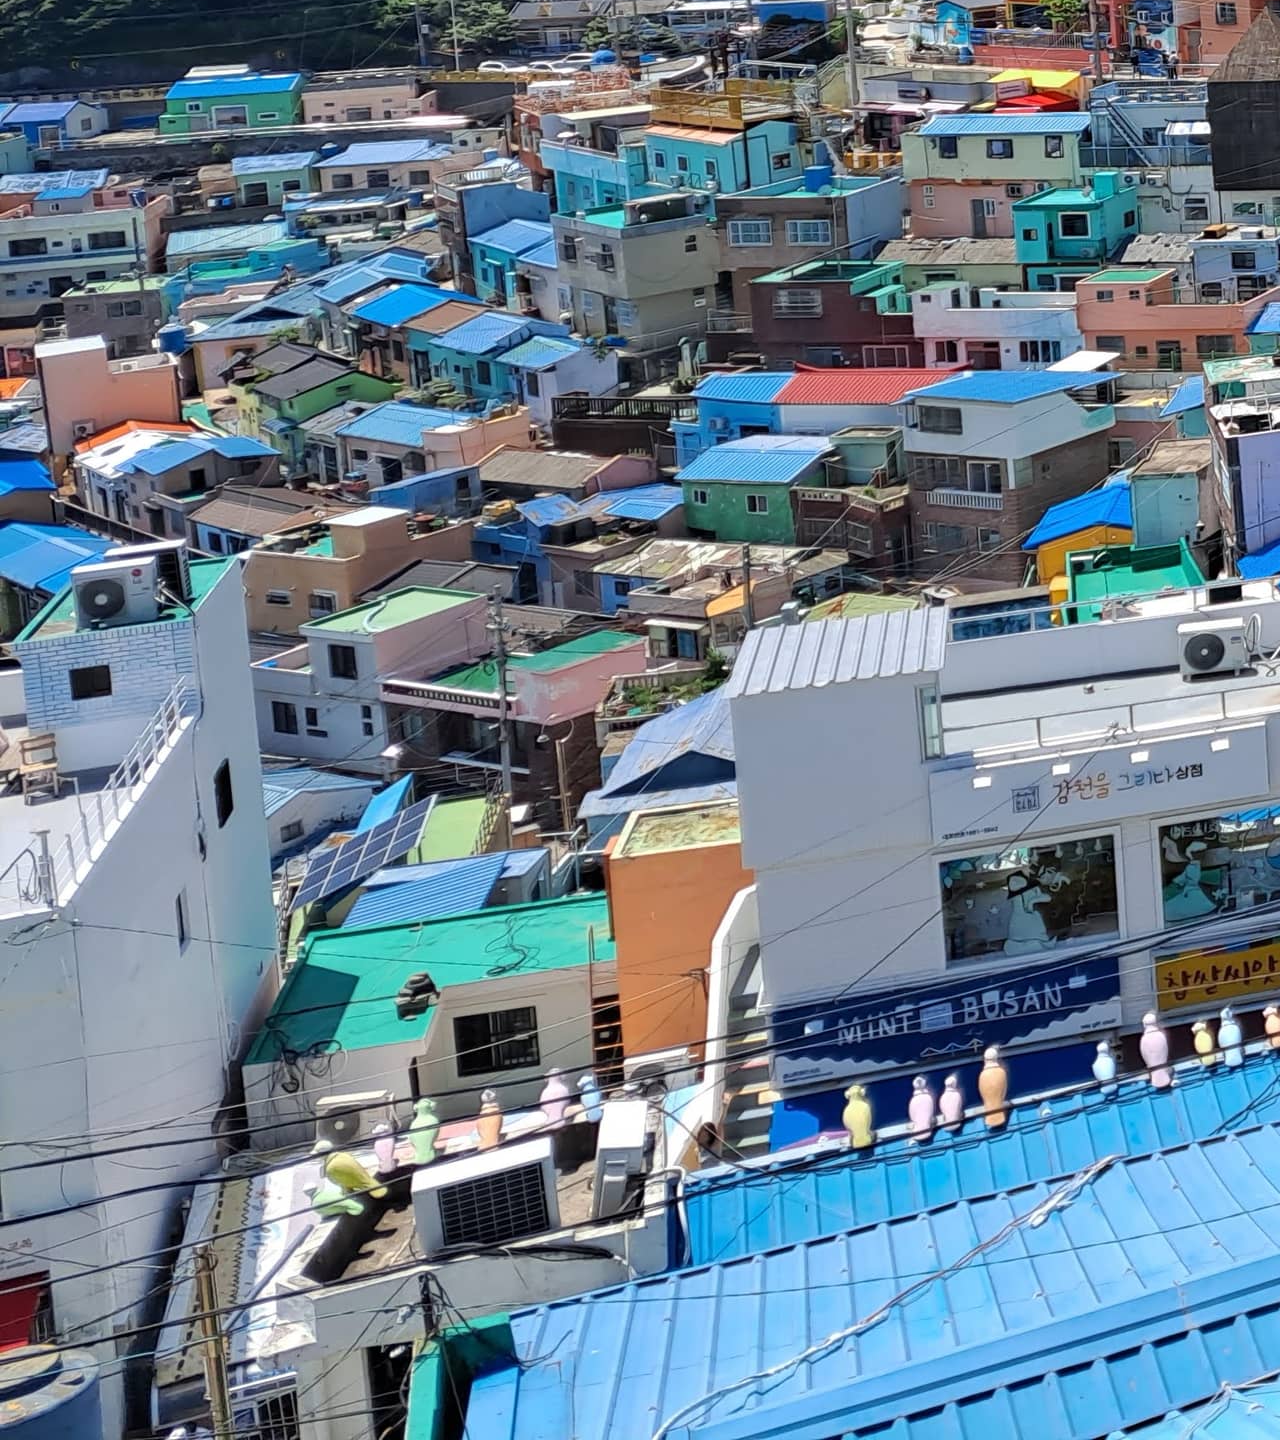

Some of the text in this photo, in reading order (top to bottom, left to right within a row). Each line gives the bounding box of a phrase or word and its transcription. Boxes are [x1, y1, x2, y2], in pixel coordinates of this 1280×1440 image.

[1175, 763, 1203, 781] 상점
[837, 982, 1063, 1047] MINT BUSAN
